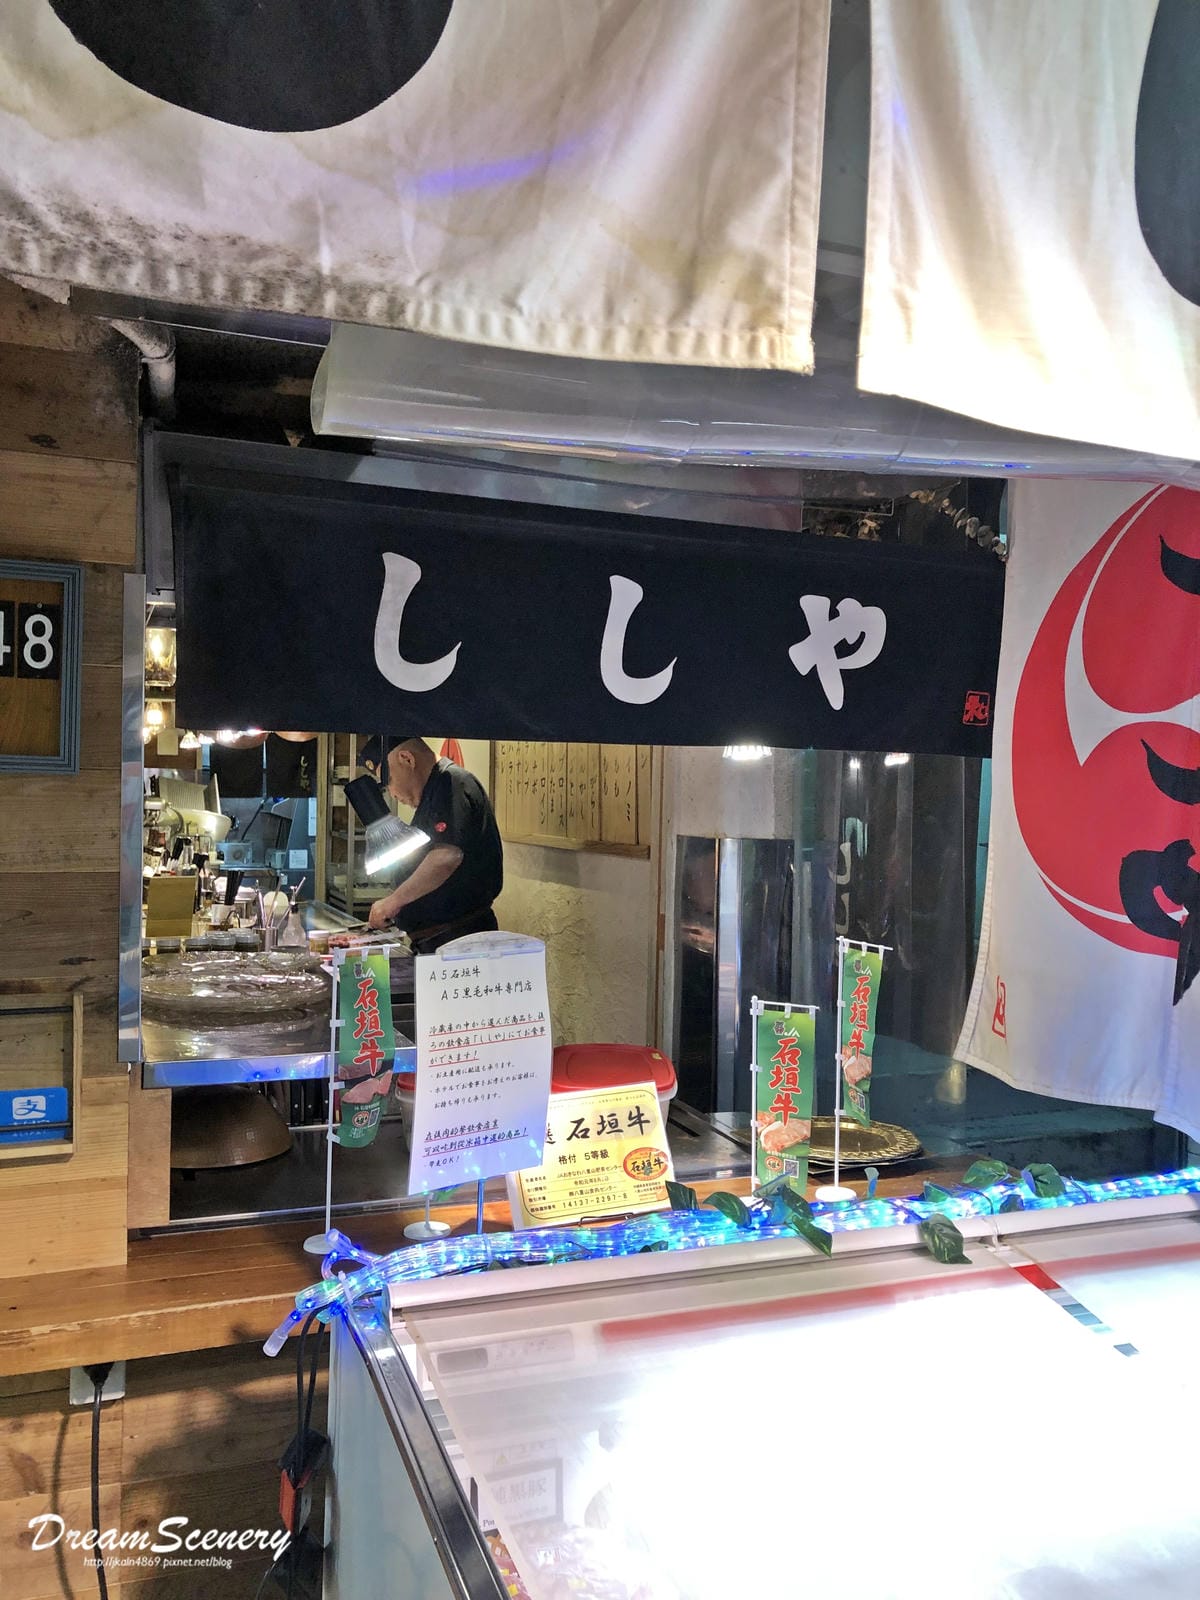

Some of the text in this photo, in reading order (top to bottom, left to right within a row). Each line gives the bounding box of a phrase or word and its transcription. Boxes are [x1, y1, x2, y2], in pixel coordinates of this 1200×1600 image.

[374, 551, 887, 711] ししや
[353, 978, 385, 1077] 石垣牛
[849, 975, 871, 1061] 石垣牛
[566, 1105, 651, 1141] 石垣牛
[768, 1037, 802, 1128] 石垣牛
